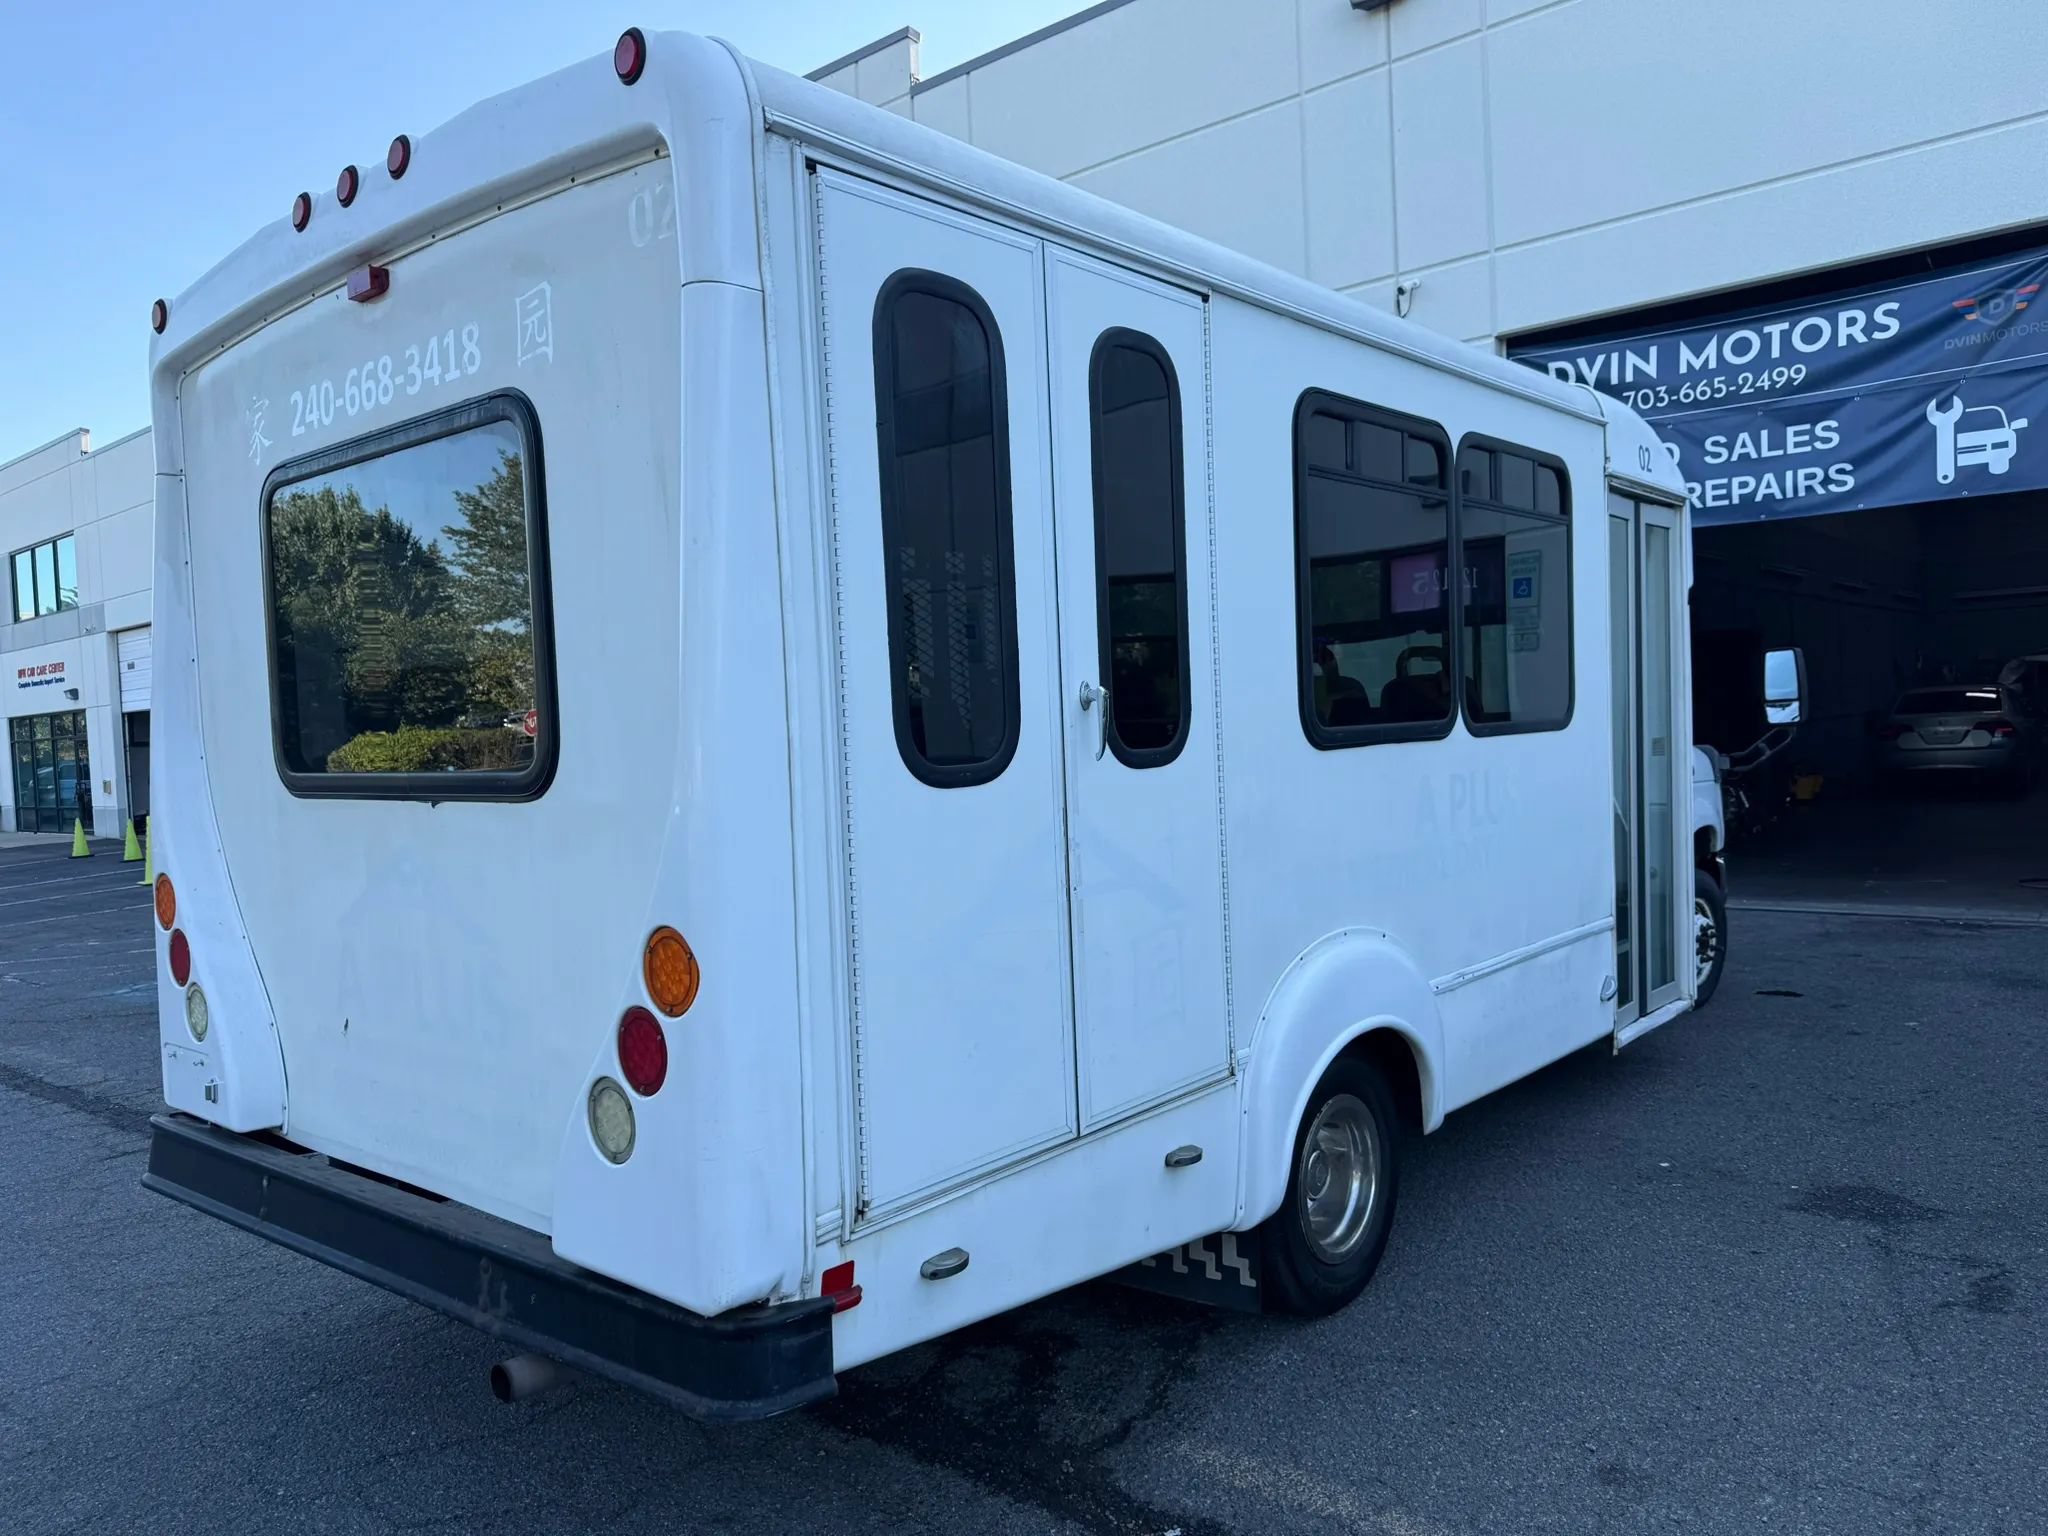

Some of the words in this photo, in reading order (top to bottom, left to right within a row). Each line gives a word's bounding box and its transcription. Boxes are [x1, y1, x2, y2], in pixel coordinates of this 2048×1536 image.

[1679, 301, 1901, 375] MOTORS
[289, 320, 481, 437] 240-668-3418
[1622, 363, 1807, 410] 703-665-2499
[1638, 443, 1653, 474] 02
[1703, 419, 1841, 465] SALES
[1684, 462, 1855, 510] REPAIRS
